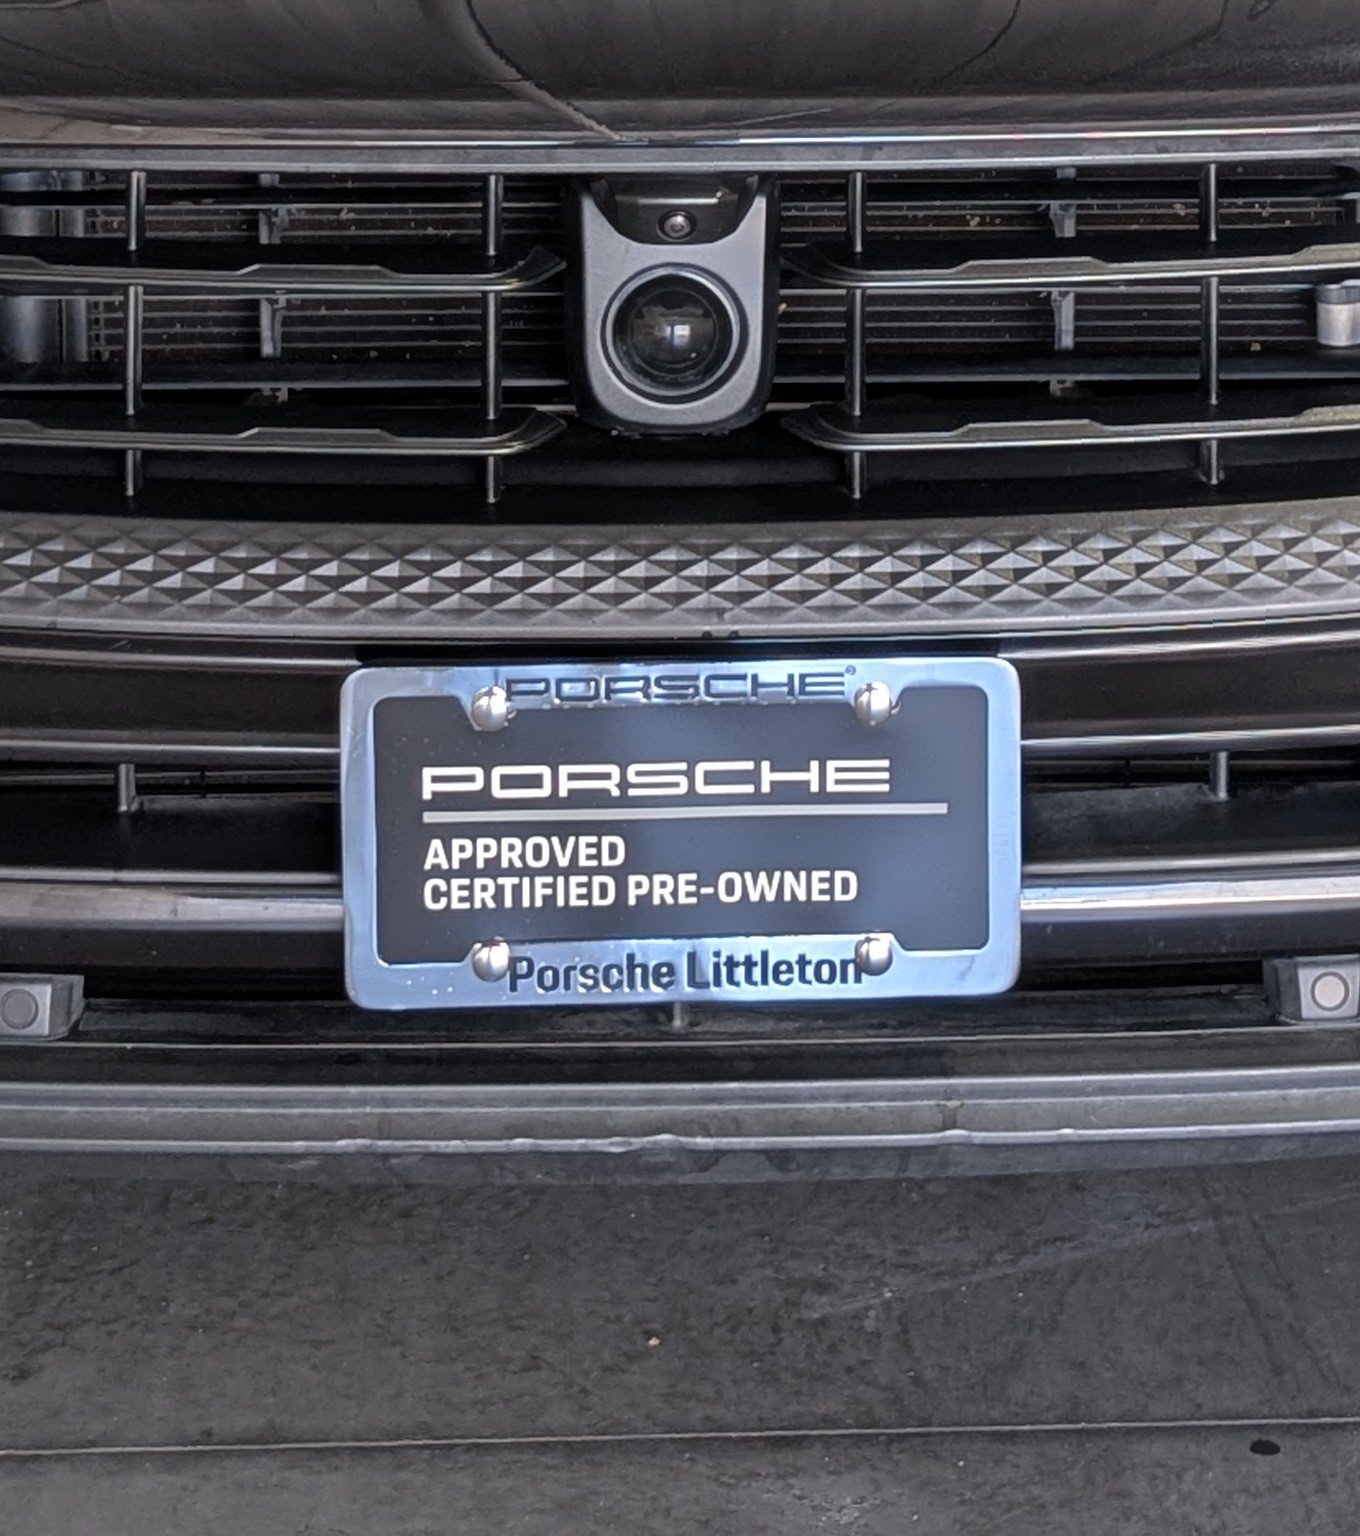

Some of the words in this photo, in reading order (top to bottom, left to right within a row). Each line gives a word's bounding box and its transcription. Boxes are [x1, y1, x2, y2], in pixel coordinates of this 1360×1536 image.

[422, 759, 890, 800] PORSCHE
[423, 835, 626, 871] APPROVED
[423, 875, 616, 910] CERTIFIED
[627, 870, 858, 906] PRE-OWNED
[508, 952, 676, 992] Porsche
[687, 949, 862, 990] Littleton
